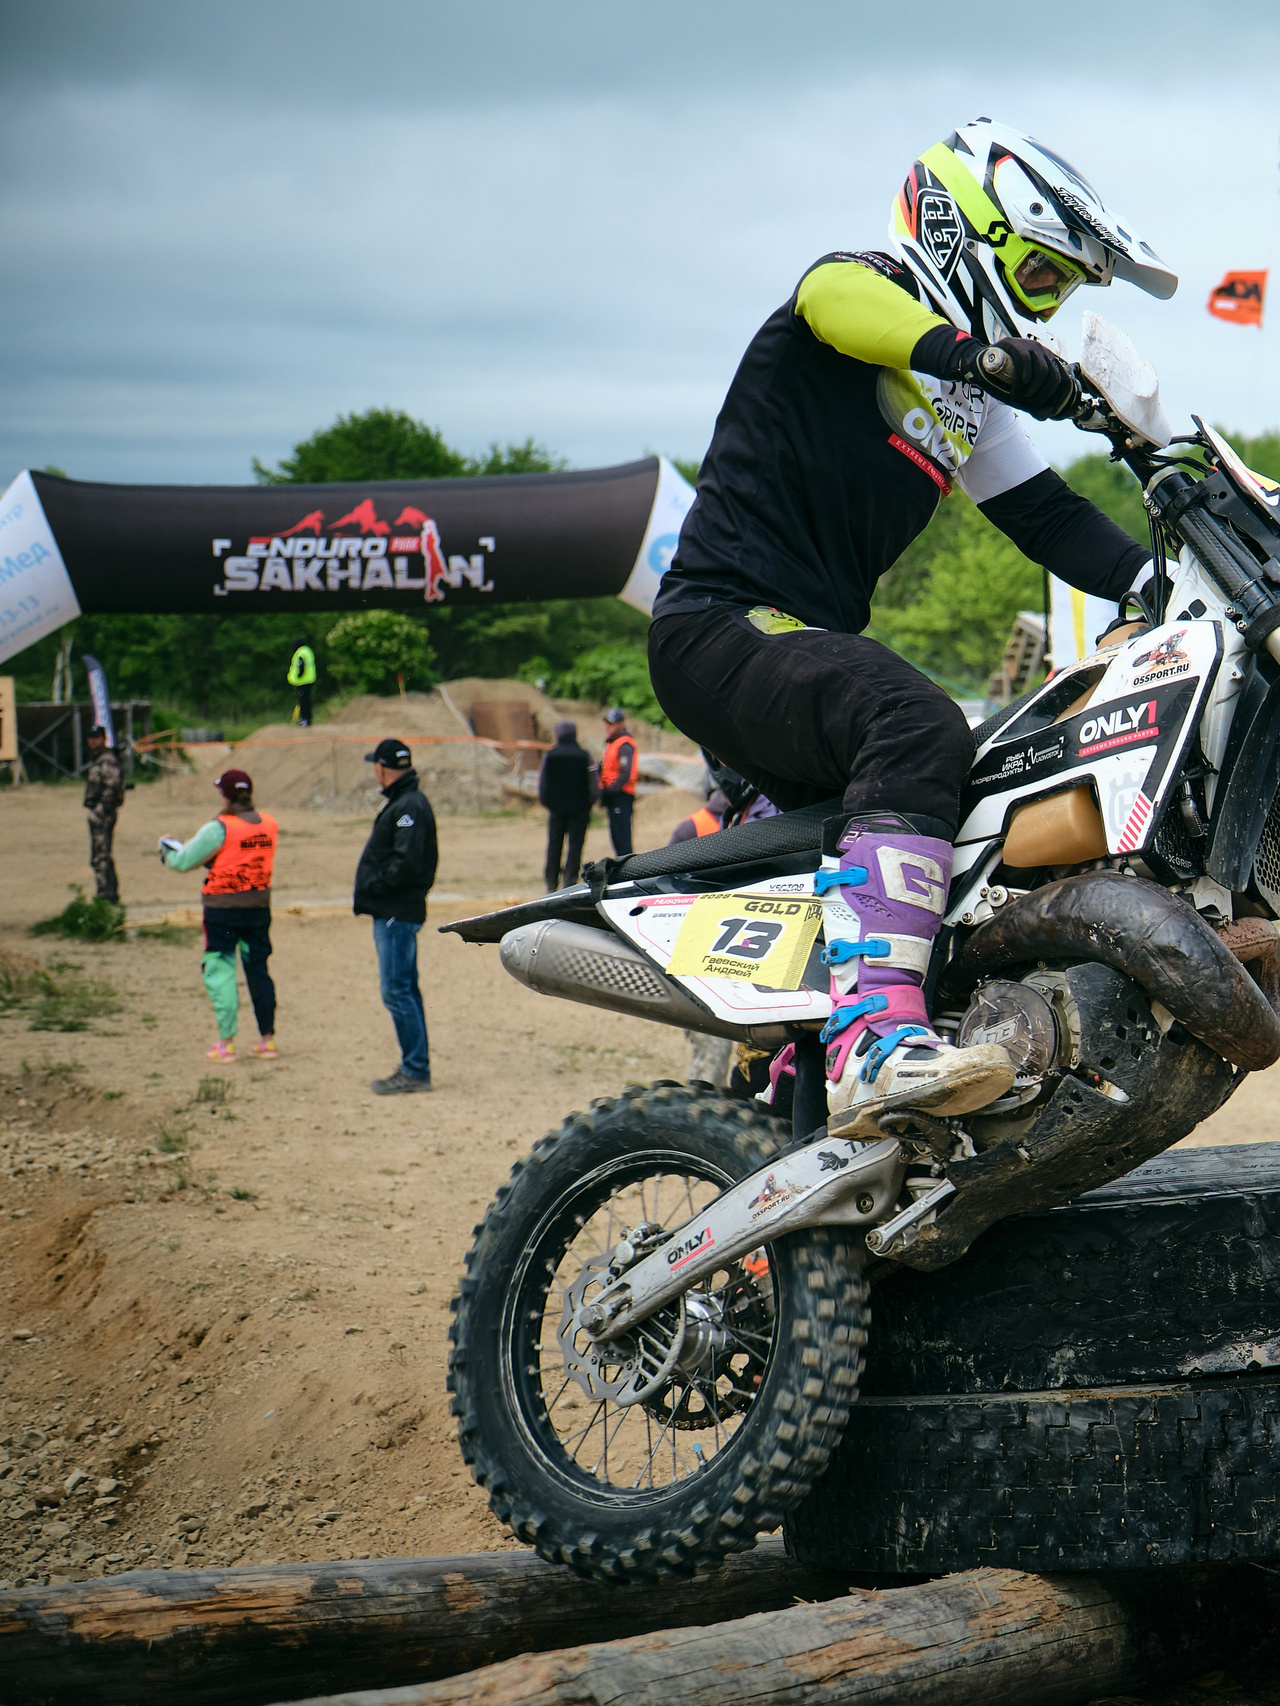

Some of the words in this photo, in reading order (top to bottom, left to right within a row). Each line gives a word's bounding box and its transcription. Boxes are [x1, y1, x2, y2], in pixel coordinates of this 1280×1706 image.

[895, 440, 927, 466] EXTREME
[246, 536, 388, 558] ENDURO
[1133, 662, 1190, 687] OSSPORT.RU
[1079, 700, 1157, 744] ONLY1
[1083, 743, 1107, 754] EXTREME
[1109, 735, 1132, 746] ENDURO
[1134, 730, 1154, 739] PARTS
[1002, 759, 1024, 771] ИКРА
[1006, 752, 1025, 762] РЫБА
[971, 766, 1023, 786] МОРЕПРОДУКТЫ
[851, 823, 870, 831] SG
[744, 901, 801, 915] GOLD
[711, 917, 783, 960] 13
[702, 956, 760, 971] Гаевский
[704, 964, 752, 978] Андрей
[752, 1194, 790, 1220] OSSPORT.RU
